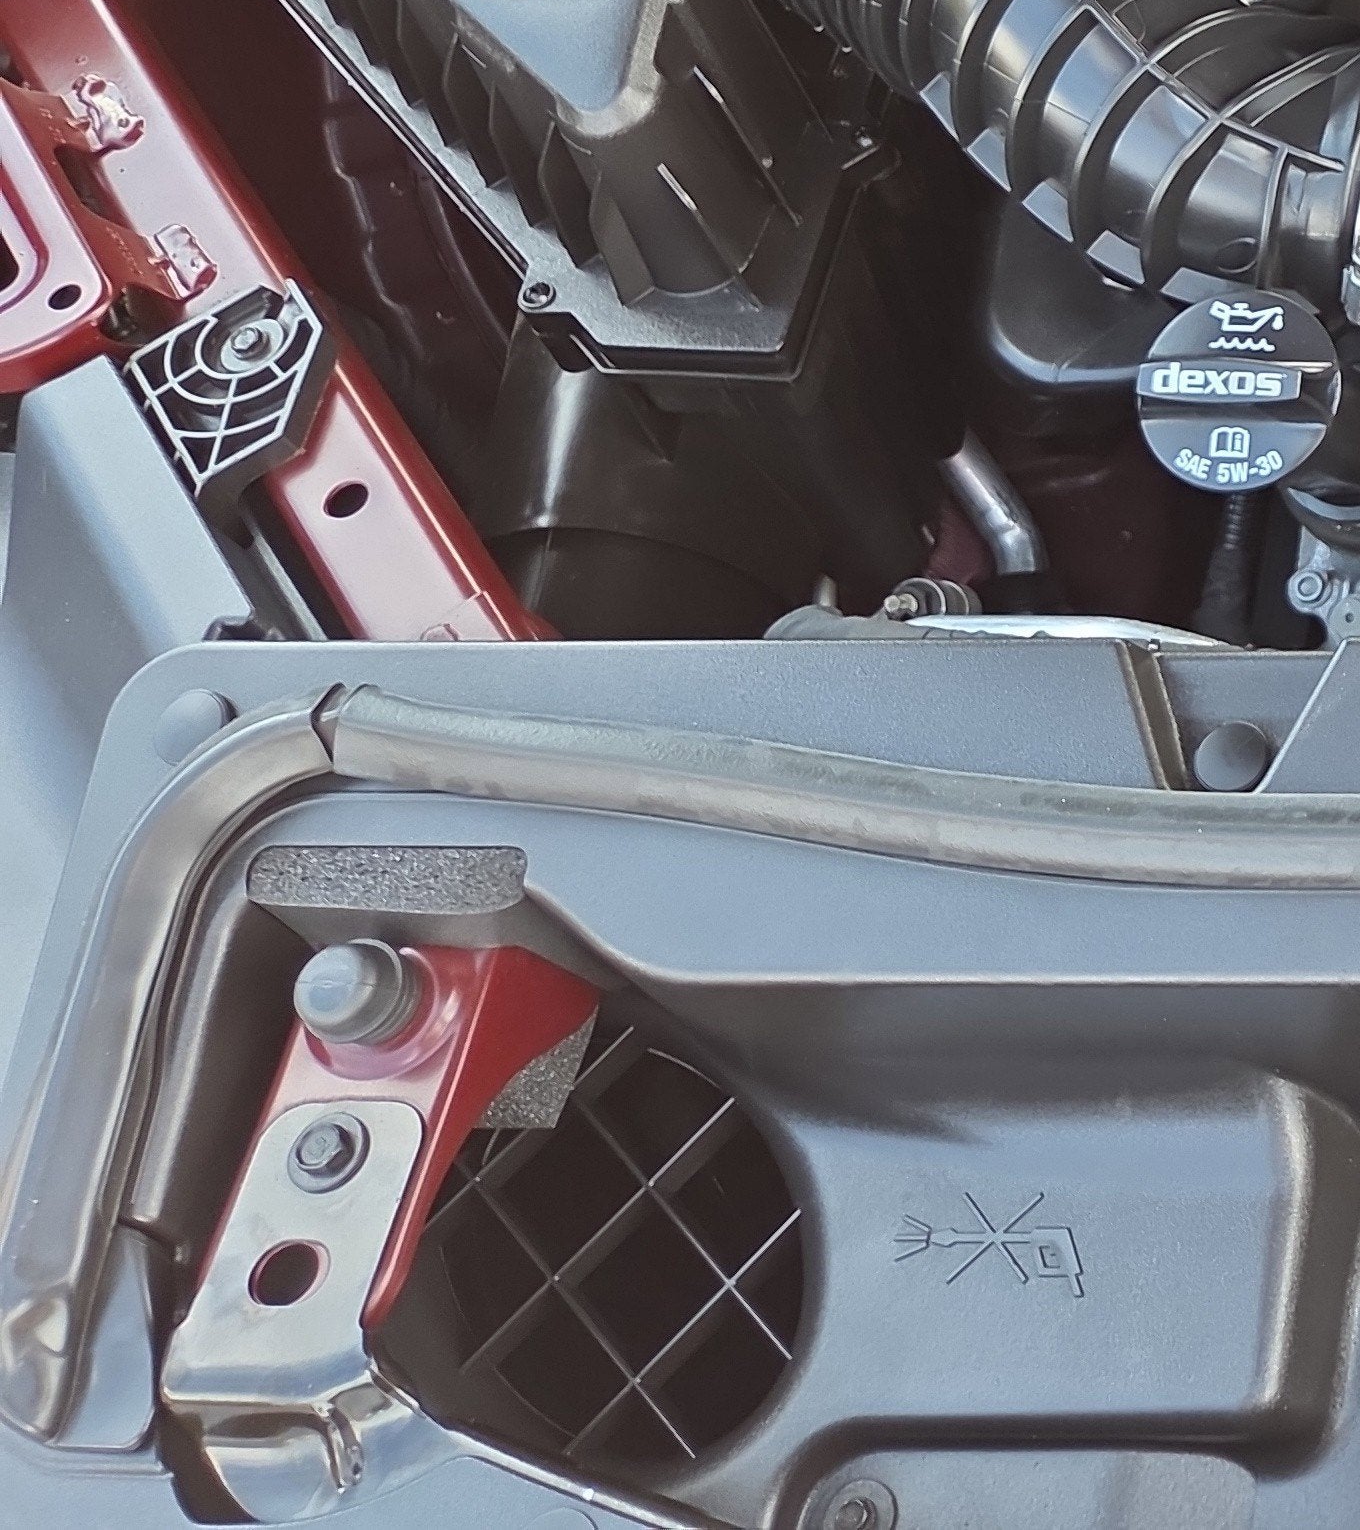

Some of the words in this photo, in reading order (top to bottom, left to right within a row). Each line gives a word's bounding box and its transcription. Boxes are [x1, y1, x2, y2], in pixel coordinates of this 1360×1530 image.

[1151, 362, 1284, 397] dexos
[1175, 448, 1213, 482] SAE
[1216, 450, 1284, 484] 5W-30
